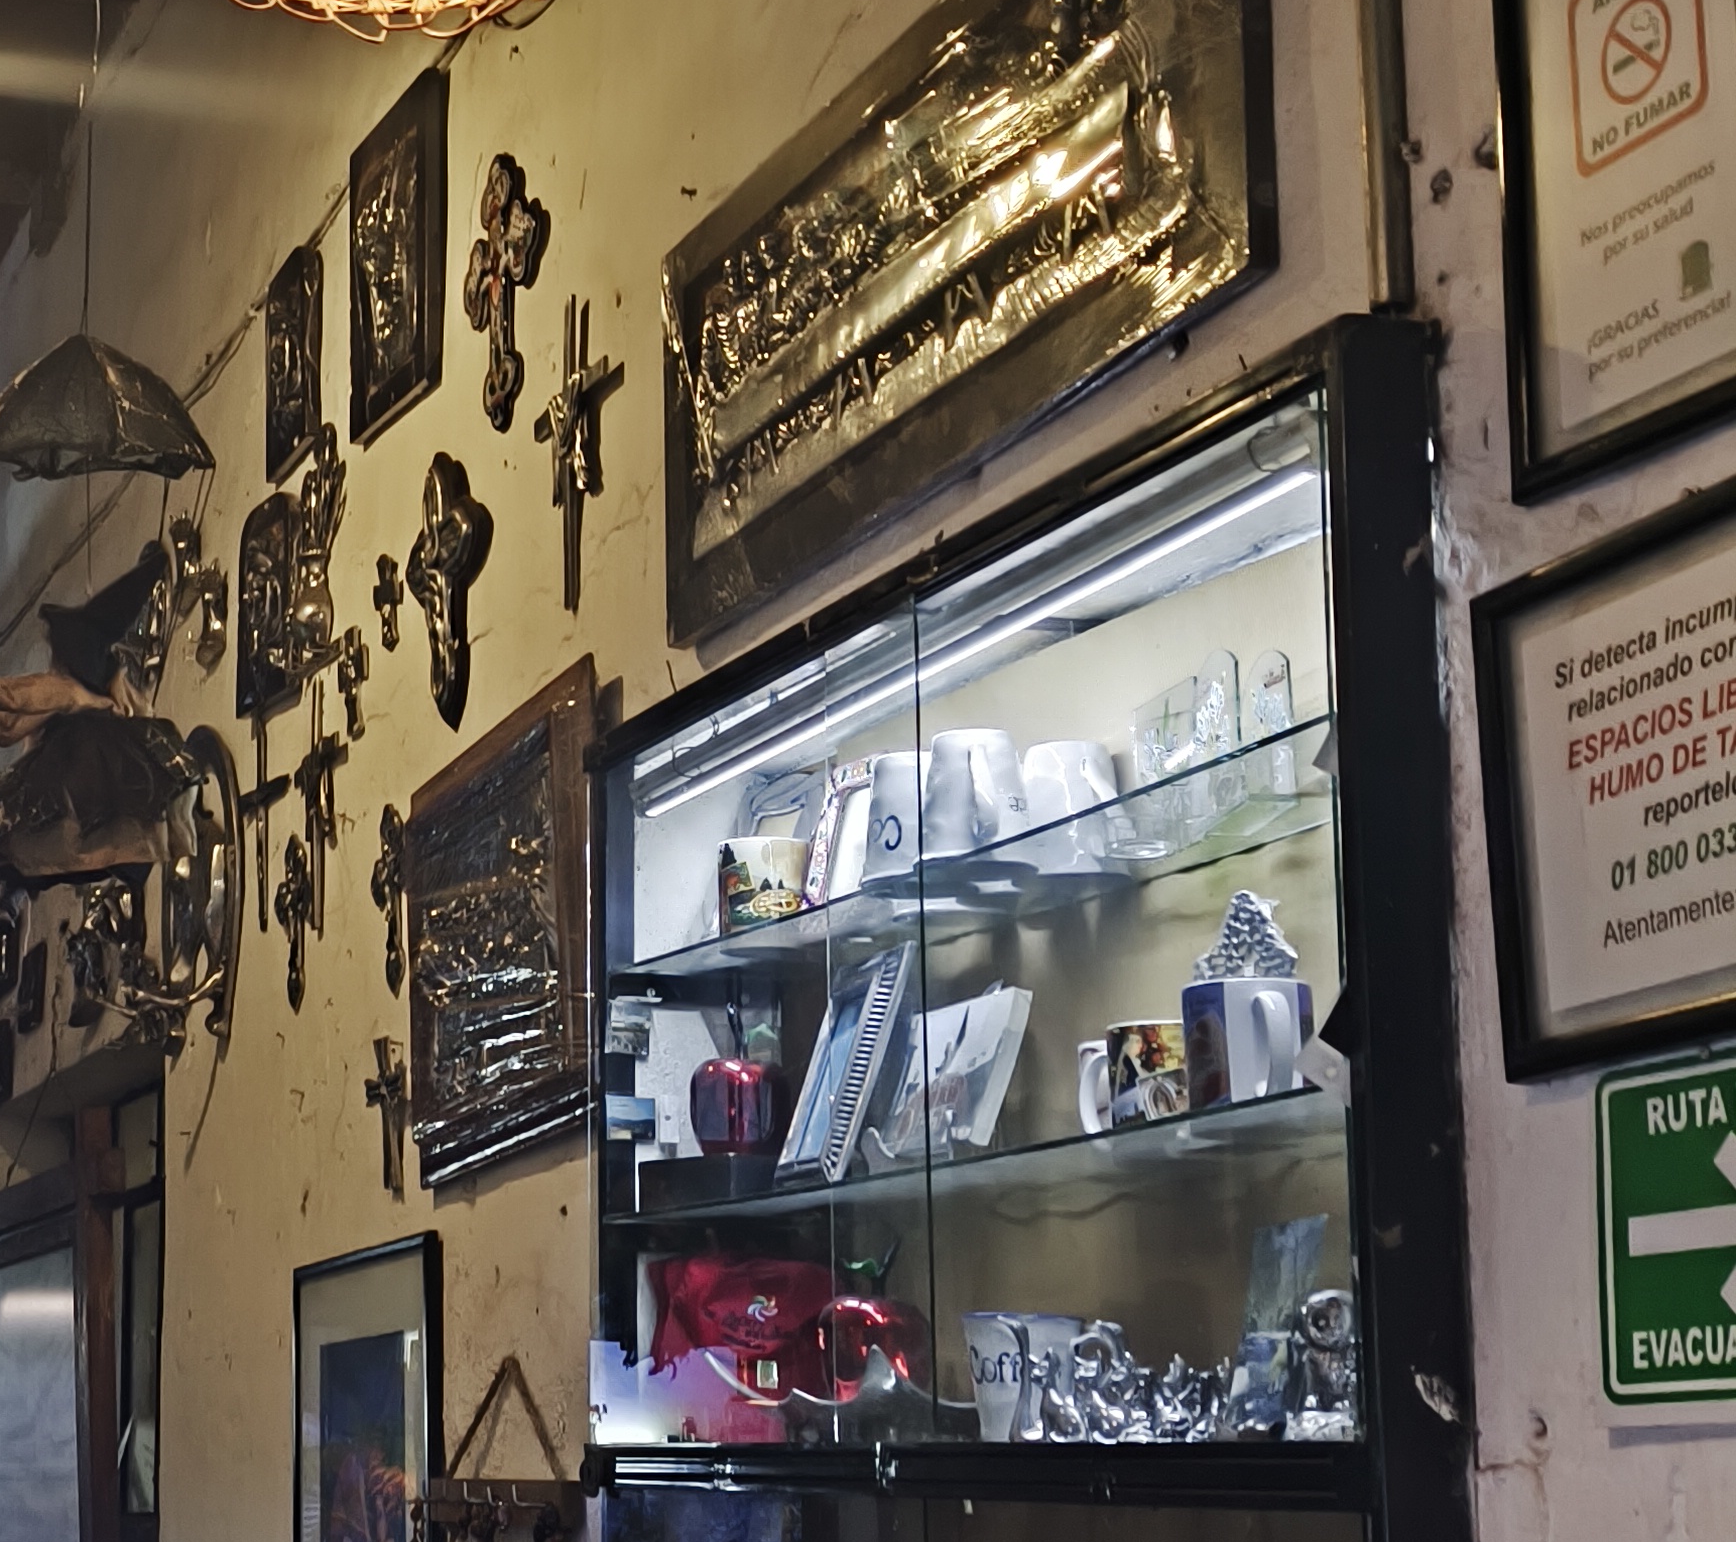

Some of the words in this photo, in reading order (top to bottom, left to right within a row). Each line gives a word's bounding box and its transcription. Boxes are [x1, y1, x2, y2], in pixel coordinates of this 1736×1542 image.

[1591, 126, 1619, 157] NO
[1624, 81, 1692, 137] FUMAR
[1579, 221, 1609, 247] Nos
[1611, 159, 1716, 234] preocupamos
[1602, 235, 1629, 266] por
[1631, 224, 1651, 246] su
[1652, 195, 1695, 235] salud
[1587, 352, 1616, 384] por
[1554, 658, 1575, 689] Si
[1580, 630, 1658, 679] detecta
[1664, 596, 1736, 645] incum
[1567, 652, 1694, 723] relacionado
[1568, 696, 1694, 771] ESPACIOS
[1588, 752, 1665, 806] HUMO
[1672, 734, 1708, 776] DE
[1611, 854, 1637, 890] 01
[1646, 839, 1689, 880] 800
[1646, 1085, 1729, 1136] RUTA
